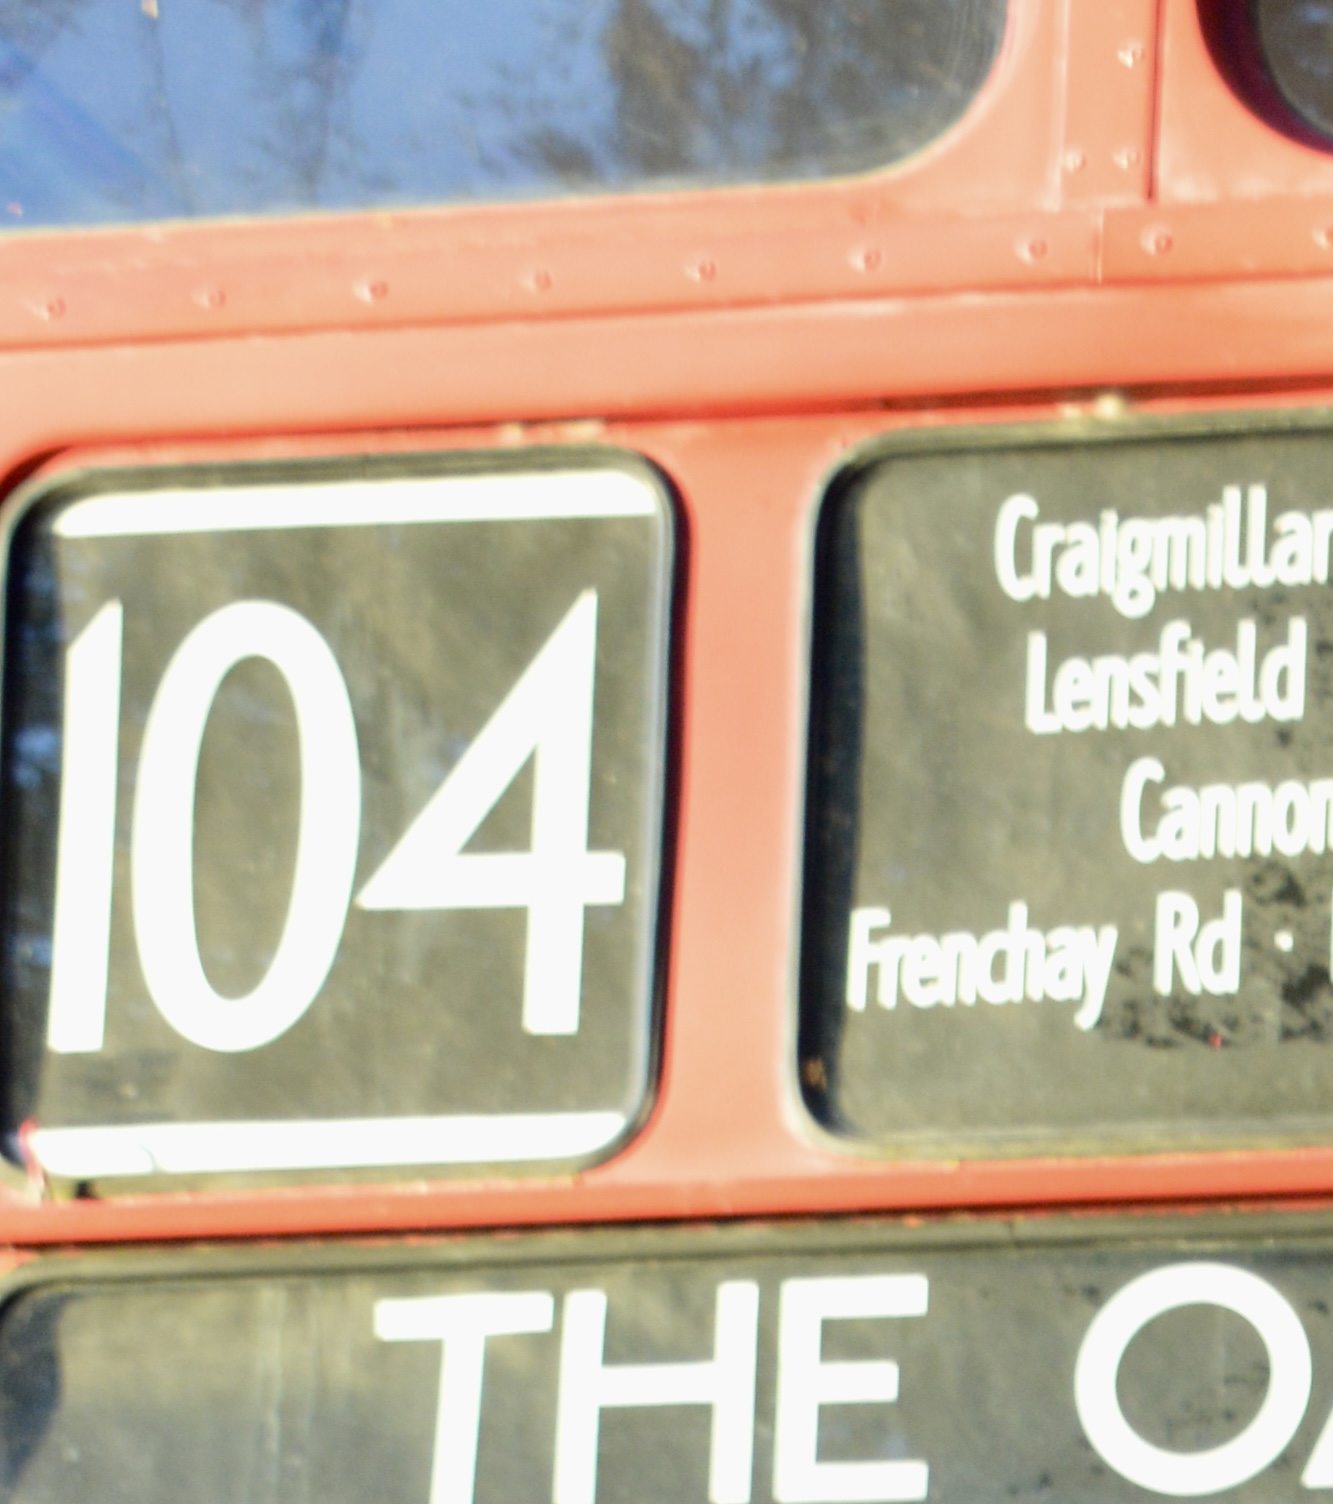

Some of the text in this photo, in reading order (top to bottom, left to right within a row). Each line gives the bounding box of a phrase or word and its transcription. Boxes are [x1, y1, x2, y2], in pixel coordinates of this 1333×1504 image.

[1022, 614, 1309, 737] Lensfield
[45, 588, 628, 1056] 104
[844, 898, 1121, 1033] Frenchay
[1151, 886, 1245, 998] Rd
